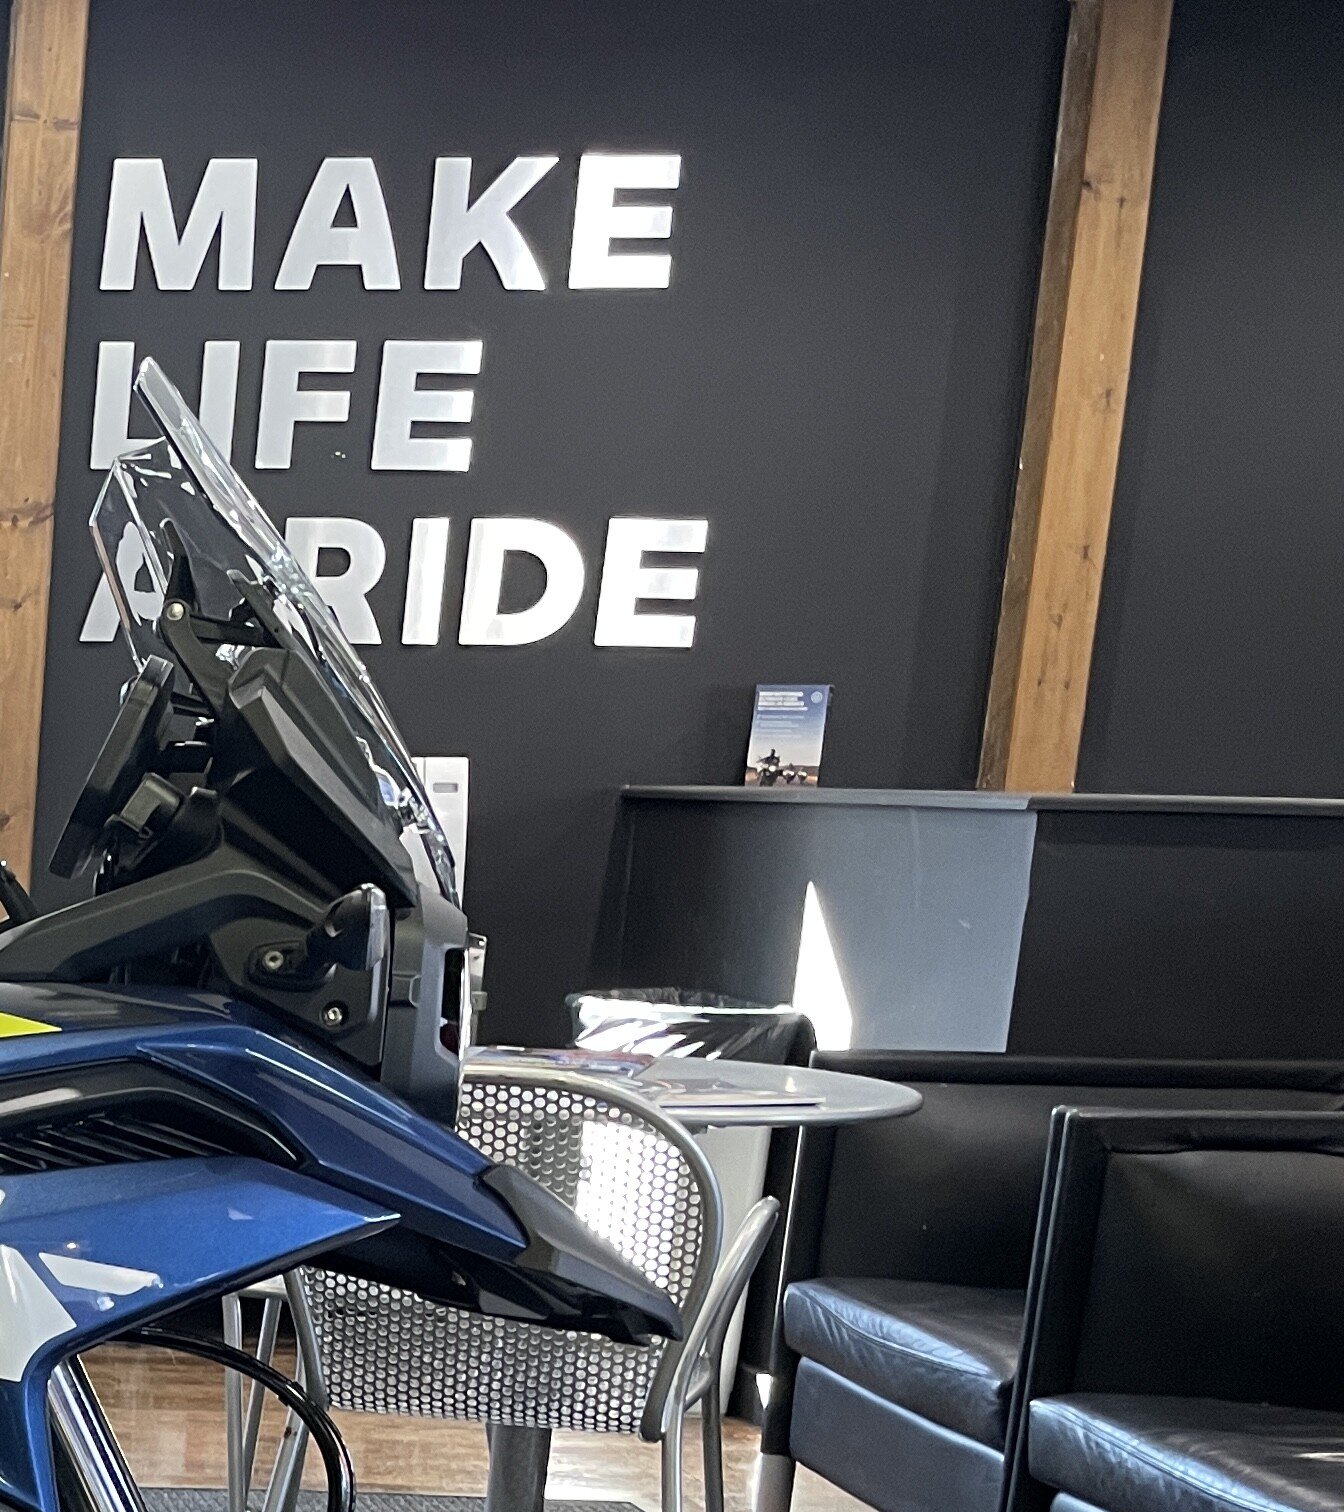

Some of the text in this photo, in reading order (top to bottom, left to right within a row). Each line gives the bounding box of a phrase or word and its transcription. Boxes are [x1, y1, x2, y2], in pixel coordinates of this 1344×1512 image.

[99, 152, 682, 292] MAKE
[88, 339, 483, 471] LIFE
[78, 516, 709, 648] A RIDE
